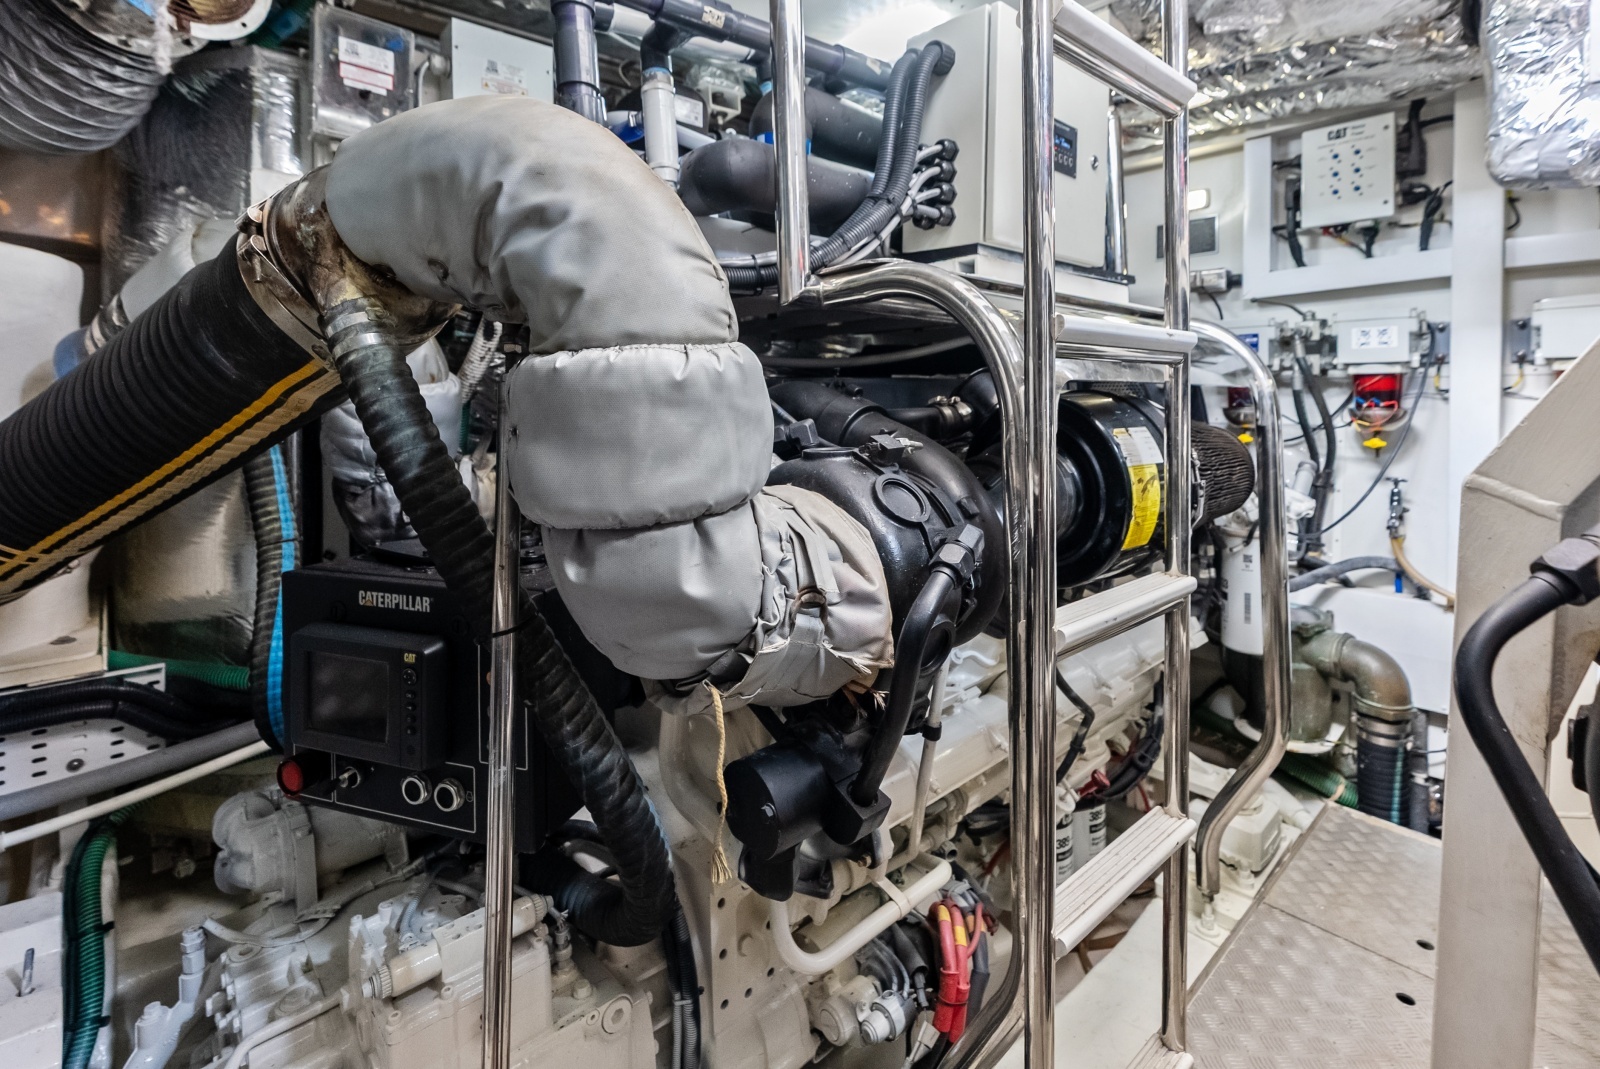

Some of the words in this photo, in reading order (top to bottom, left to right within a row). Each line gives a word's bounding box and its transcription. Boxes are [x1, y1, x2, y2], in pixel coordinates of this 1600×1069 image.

[1327, 128, 1348, 141] CAT
[359, 590, 430, 613] CATERPILLAR
[404, 652, 416, 663] CAT
